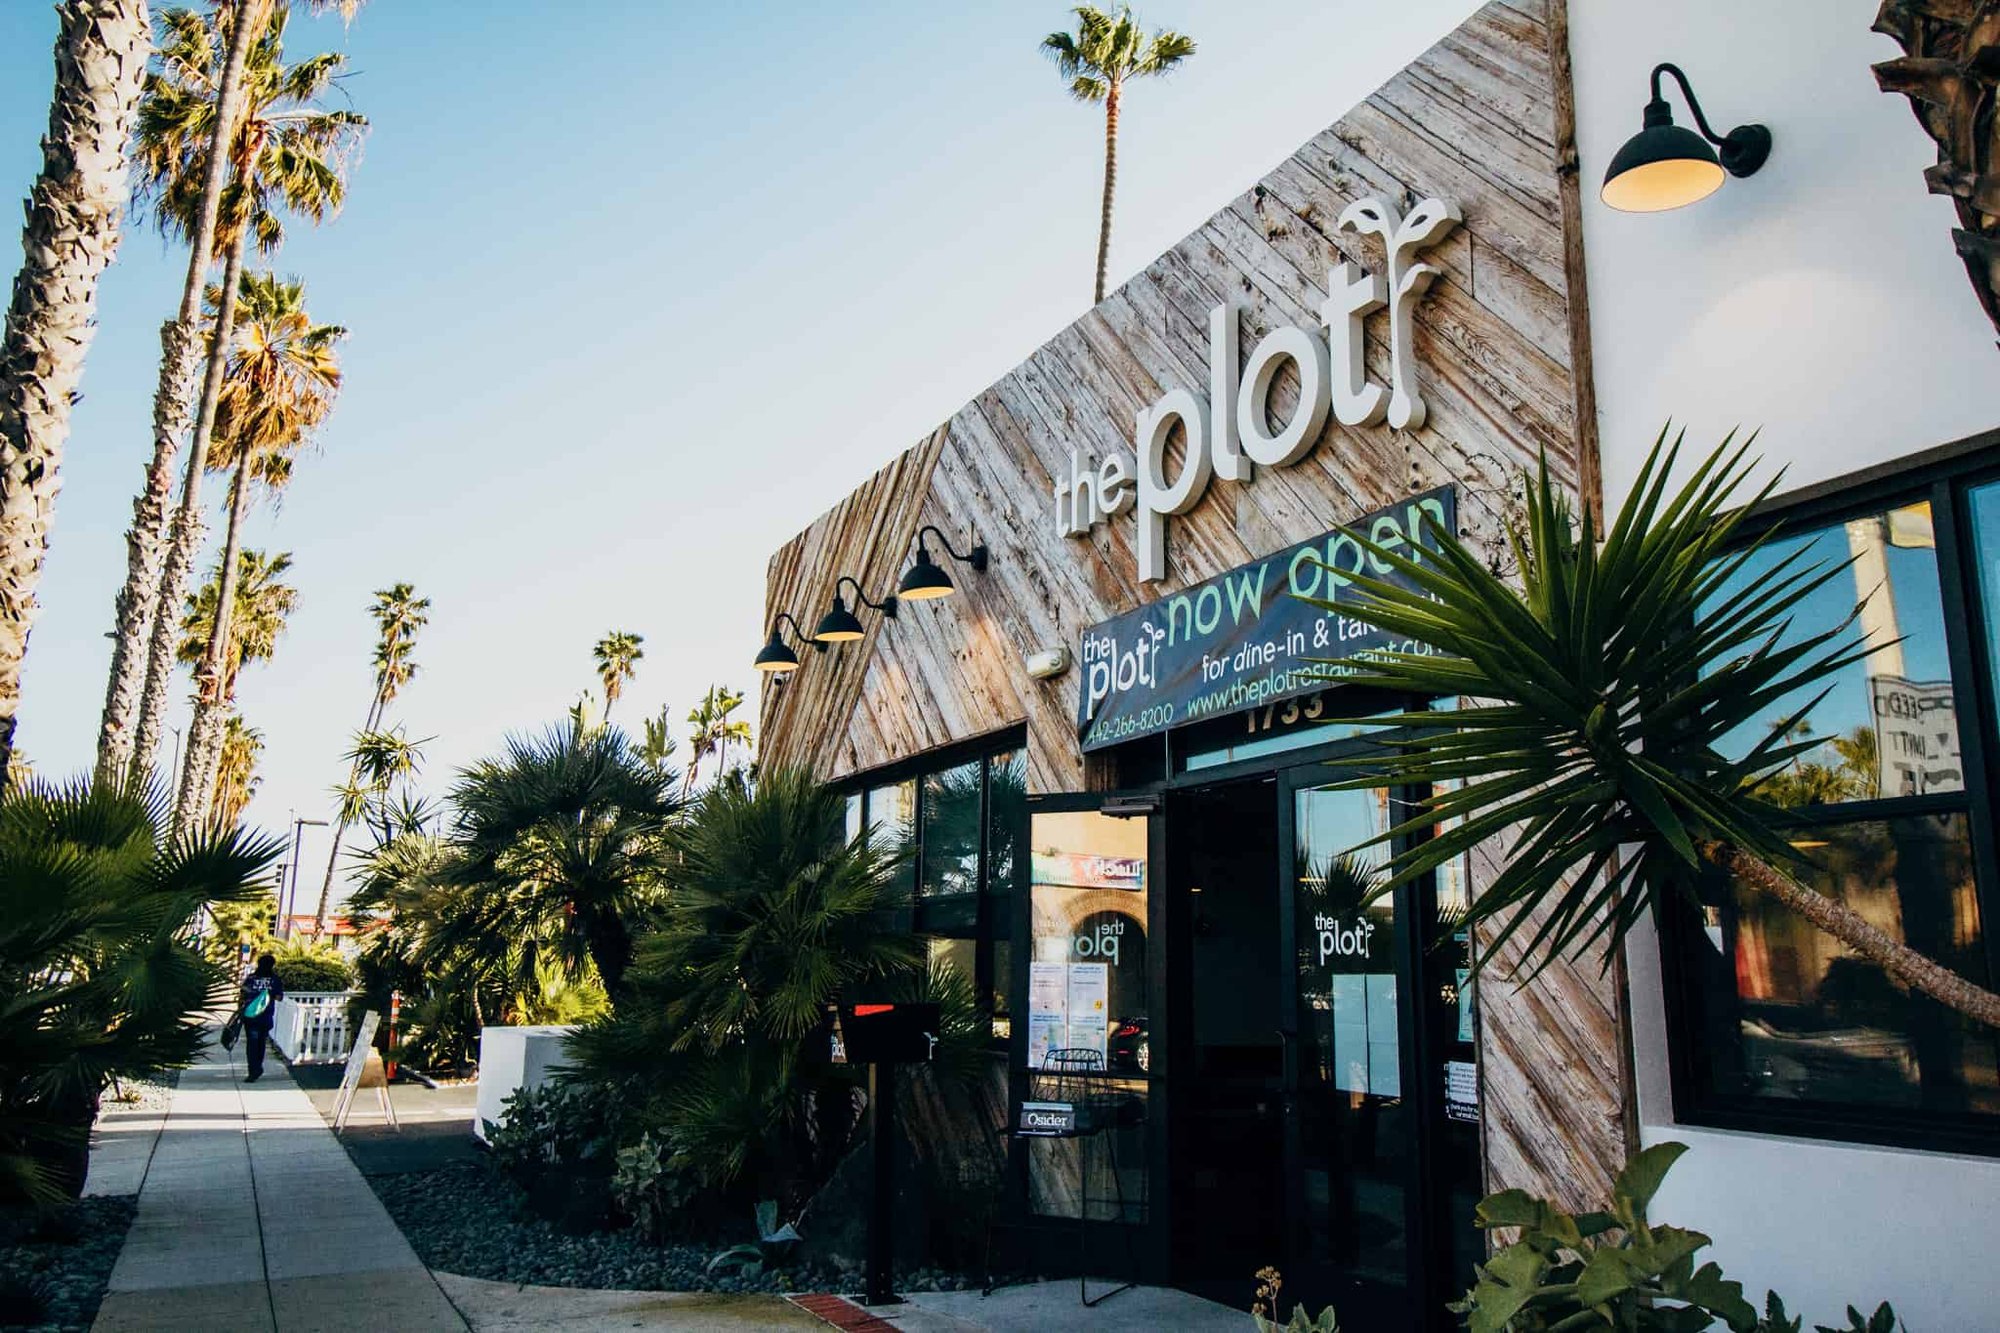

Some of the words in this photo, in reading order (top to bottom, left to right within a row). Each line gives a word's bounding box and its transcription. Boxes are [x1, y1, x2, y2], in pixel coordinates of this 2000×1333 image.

[1055, 449, 1134, 538] the
[1136, 261, 1389, 584] plot
[1168, 563, 1268, 646] now
[1288, 498, 1446, 617] open
[1084, 633, 1111, 663] the
[1202, 655, 1230, 683] for
[1233, 628, 1305, 673] dine-in
[1312, 618, 1330, 648] &
[1087, 637, 1152, 720] plot
[1315, 912, 1334, 930] the
[1320, 920, 1365, 966] plot
[1028, 1112, 1068, 1126] Osider
